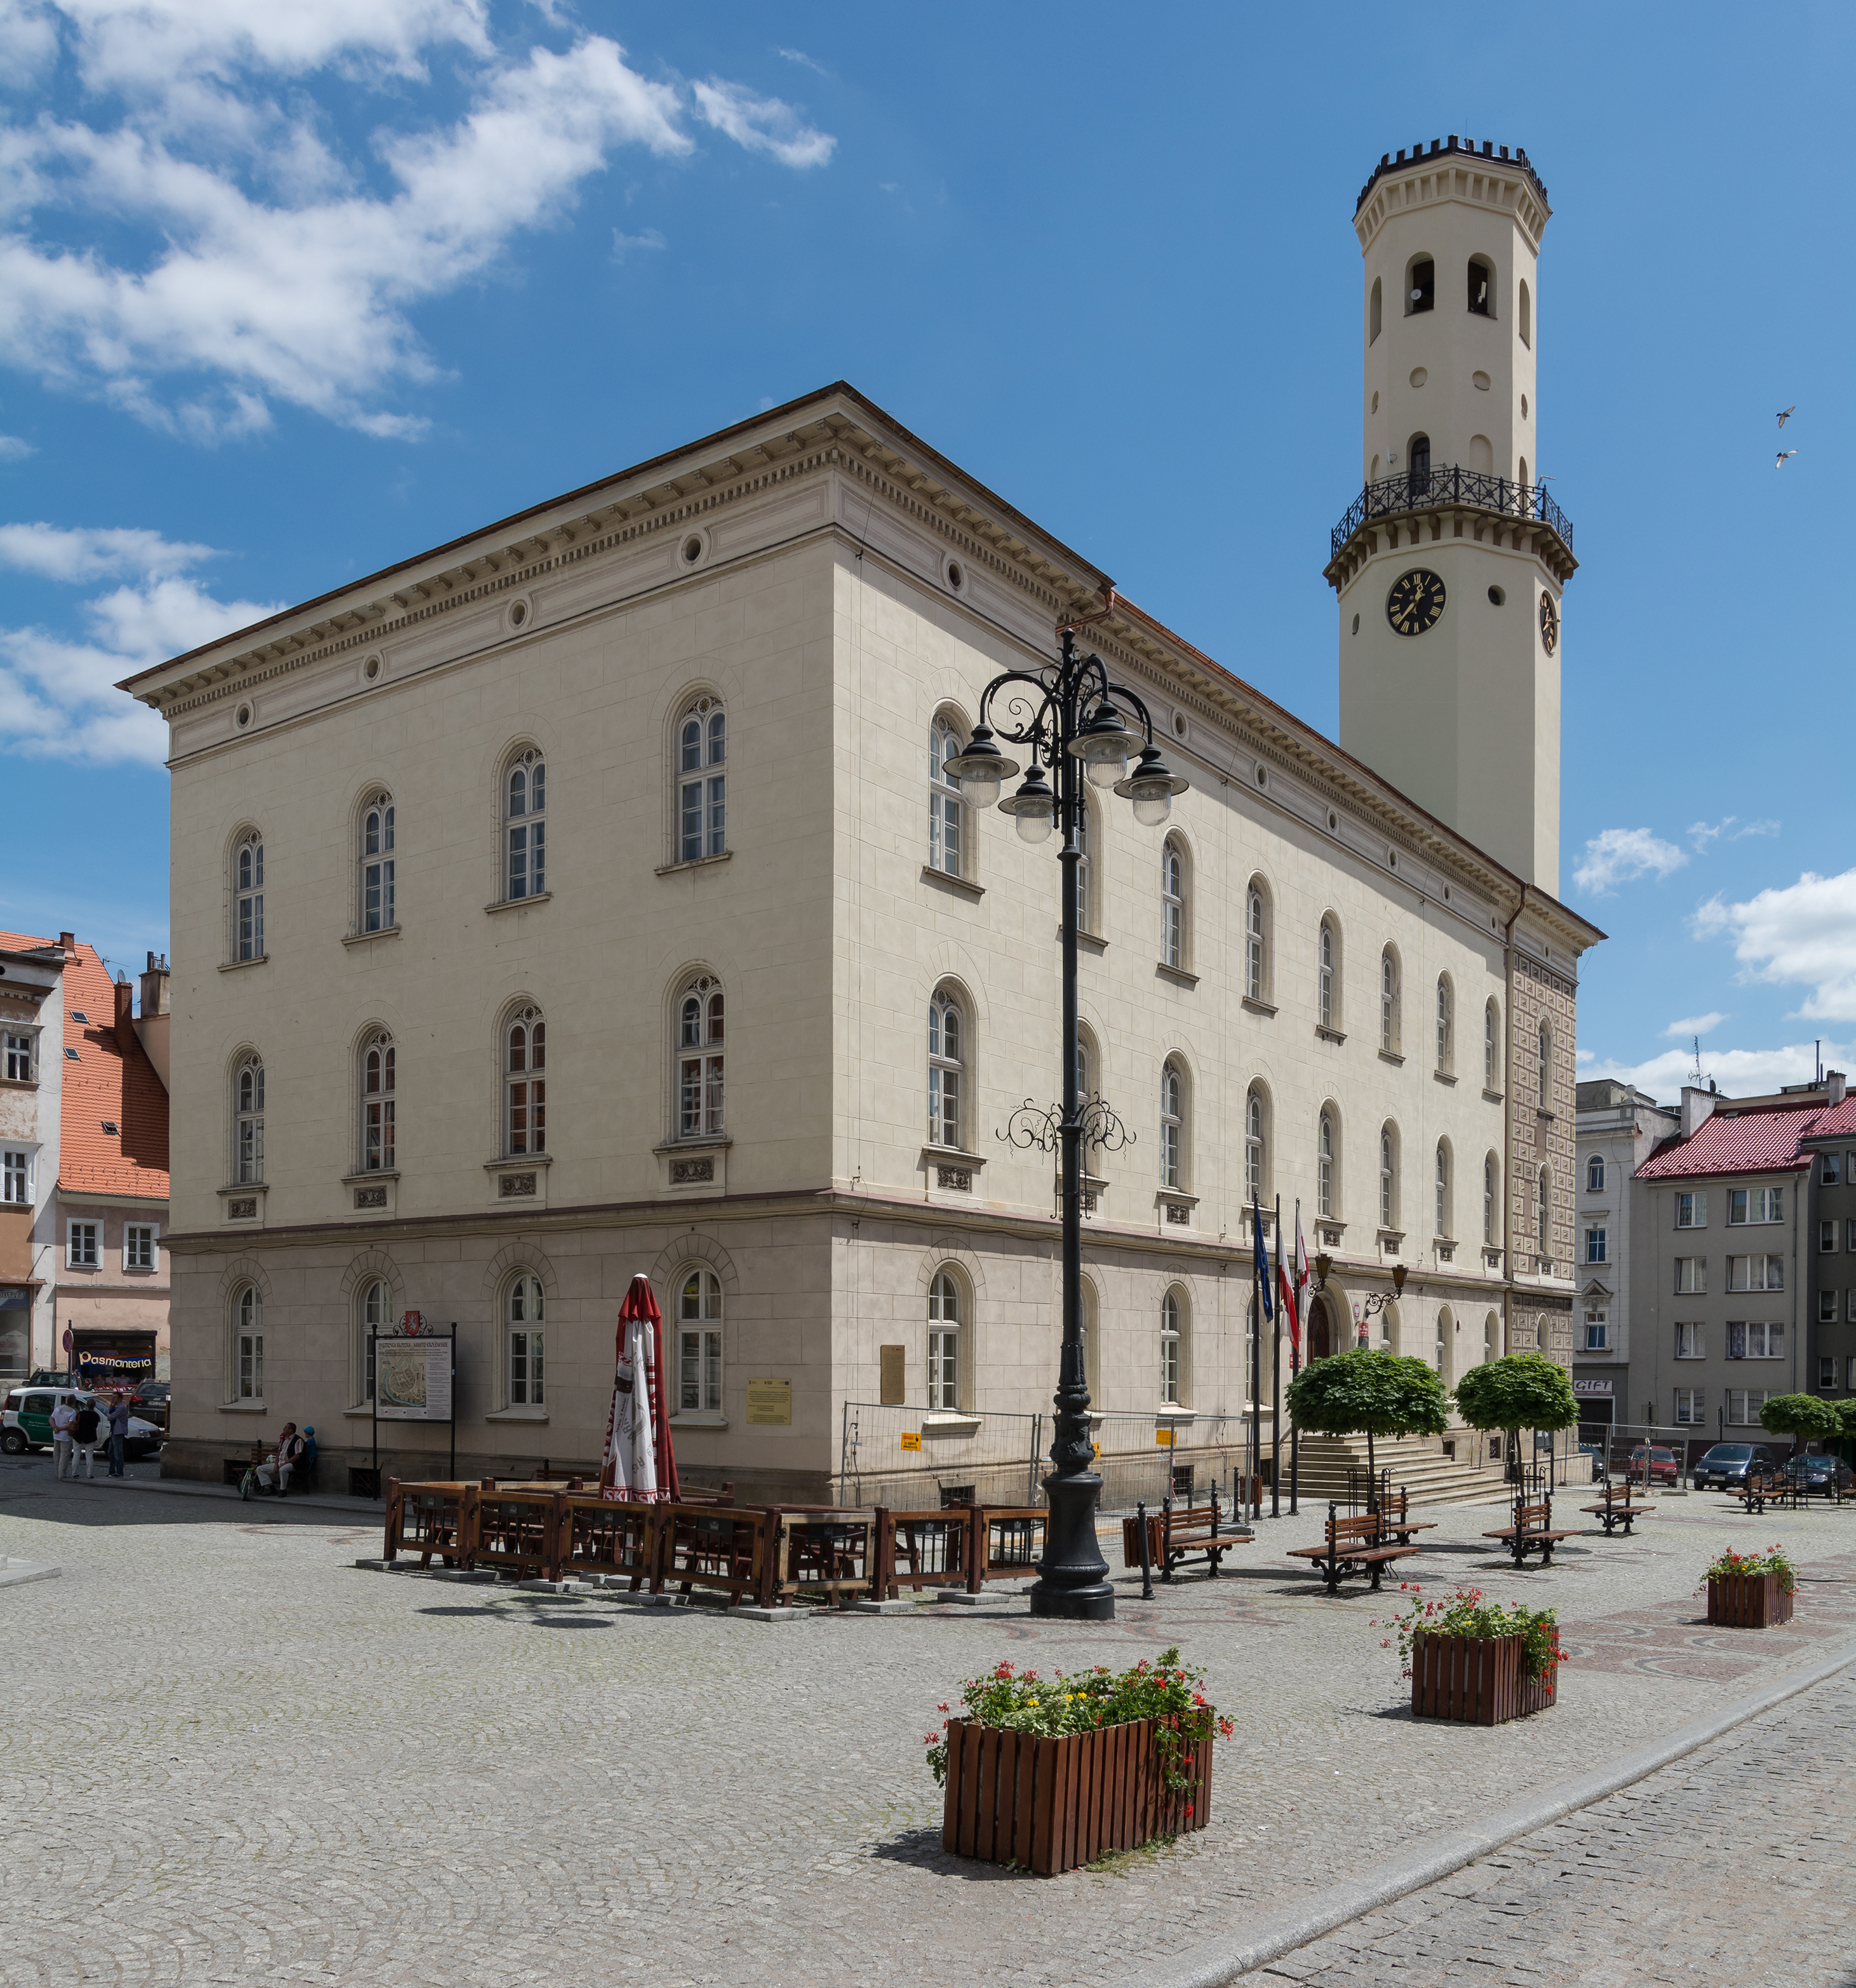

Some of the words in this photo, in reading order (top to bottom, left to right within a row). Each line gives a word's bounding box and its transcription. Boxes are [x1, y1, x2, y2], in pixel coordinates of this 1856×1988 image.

[1401, 579, 1411, 591] XI
[1430, 583, 1441, 592] II
[1434, 595, 1444, 603] III
[79, 1351, 152, 1369] Pasmanteria
[1576, 1381, 1610, 1390] GIFT
